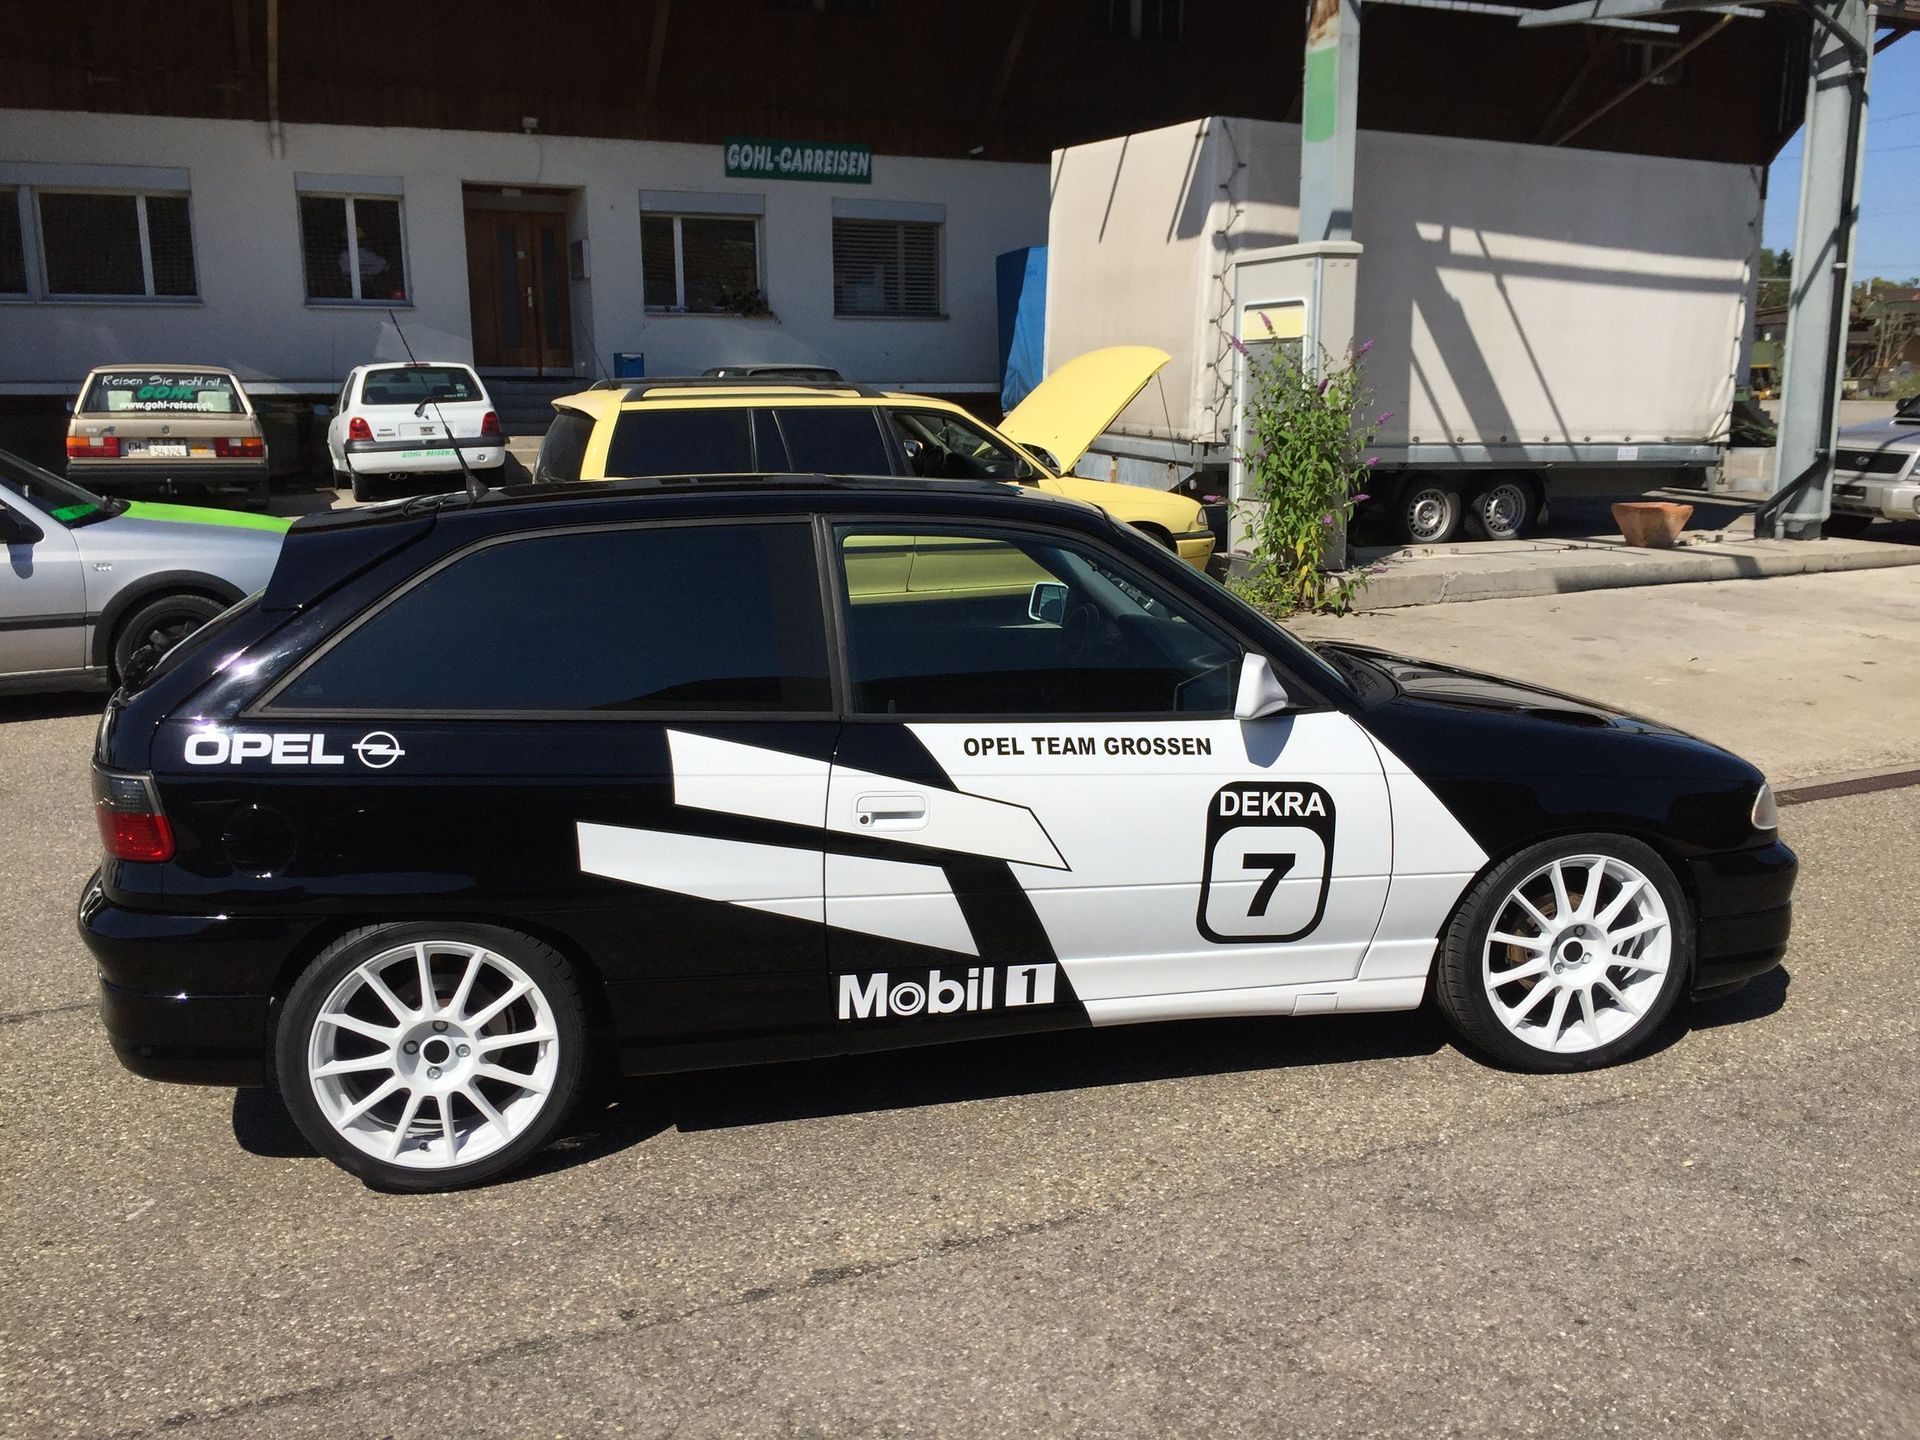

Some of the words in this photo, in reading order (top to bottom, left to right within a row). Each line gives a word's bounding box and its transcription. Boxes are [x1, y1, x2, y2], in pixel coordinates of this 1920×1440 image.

[727, 143, 870, 176] GOHL-CARREISEN
[102, 375, 143, 386] Reisen
[149, 374, 173, 387] Sie
[178, 376, 204, 387] wohl
[137, 385, 194, 399] GOHL
[119, 401, 213, 411] www.gohl-reisen.ch
[184, 733, 344, 765] OPEL
[963, 737, 1025, 756] OPEL
[1031, 737, 1096, 756] TEAM
[1104, 736, 1212, 756] GROSSEN
[1219, 790, 1327, 817] DEKRA
[1242, 852, 1296, 917] 7
[838, 966, 995, 1020] Mobil
